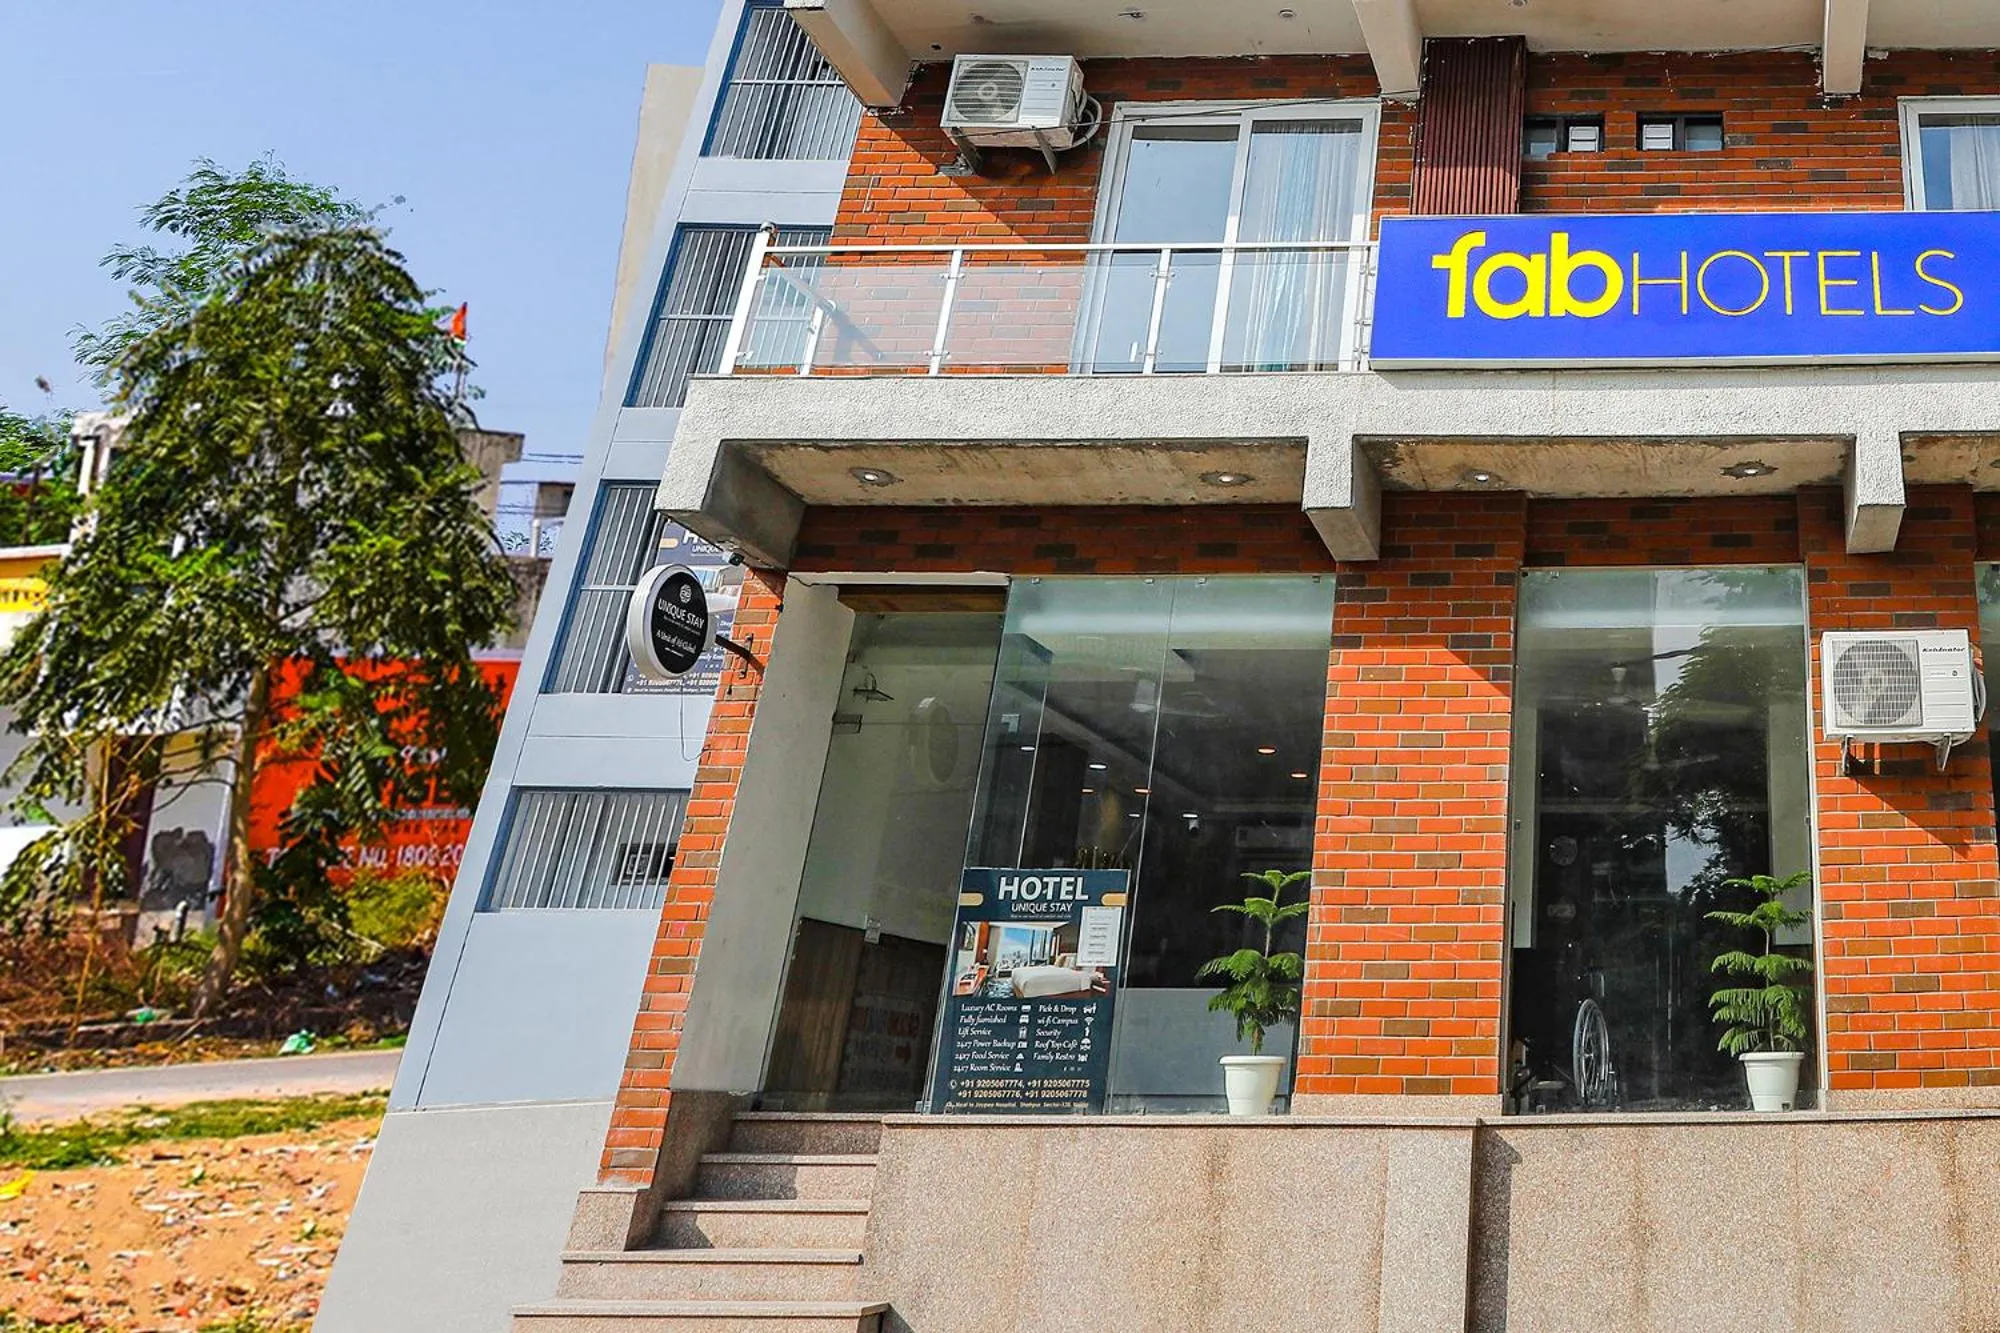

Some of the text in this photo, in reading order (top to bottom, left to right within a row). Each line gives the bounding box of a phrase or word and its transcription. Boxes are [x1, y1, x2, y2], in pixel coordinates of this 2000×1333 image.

[658, 598, 687, 620] UNIQUE
[686, 611, 705, 629] STAY
[998, 876, 1089, 901] HOTEL
[1011, 902, 1073, 914] UNIQUE STAY
[961, 1003, 1017, 1014] Luxury AC Rooms
[1039, 1004, 1055, 1013] Pick
[1060, 1004, 1078, 1015] Drop
[959, 1014, 1007, 1025] Fully furnished
[1052, 1016, 1079, 1027] Campus
[957, 1027, 992, 1038] Lift Service
[1035, 1028, 1062, 1039] Security
[972, 1039, 992, 1048] Power
[992, 1039, 1016, 1050] Backup
[971, 1051, 987, 1060] Food
[988, 1051, 1010, 1060] Service
[1032, 1052, 1054, 1063] Family
[969, 1063, 988, 1072] Room
[989, 1063, 1012, 1072] Service
[960, 1079, 975, 1088] +91
[1027, 1079, 1041, 1088] +91
[957, 1090, 972, 1099] +91
[1025, 1090, 1039, 1098] +91
